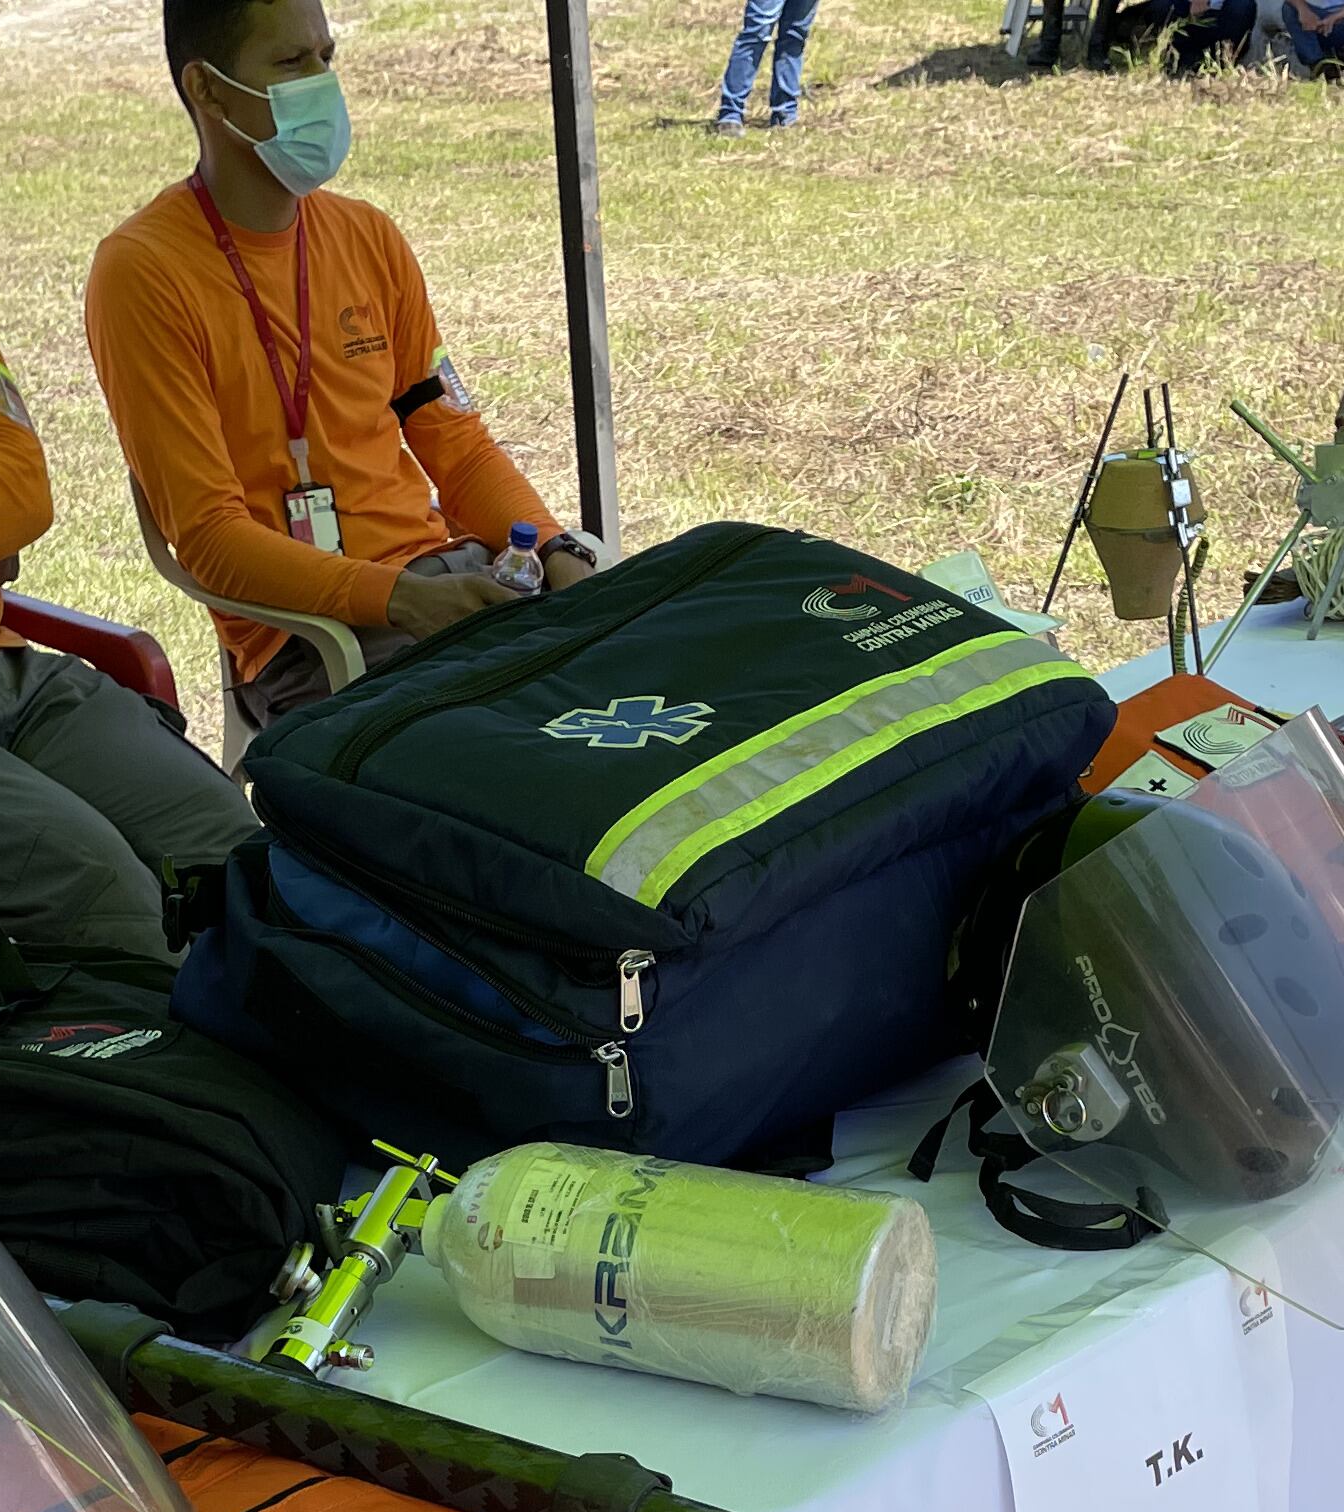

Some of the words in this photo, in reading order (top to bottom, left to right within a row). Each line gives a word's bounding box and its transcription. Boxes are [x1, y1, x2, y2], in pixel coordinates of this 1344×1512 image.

[842, 621, 894, 642] CAMPAÑA
[887, 599, 950, 626] COLOMBIANA
[856, 625, 919, 652] CONTRA
[911, 606, 964, 631] MINAS
[1075, 954, 1113, 1024] PRO
[1125, 1059, 1167, 1125] TEC
[1144, 1431, 1204, 1487] T.K.
